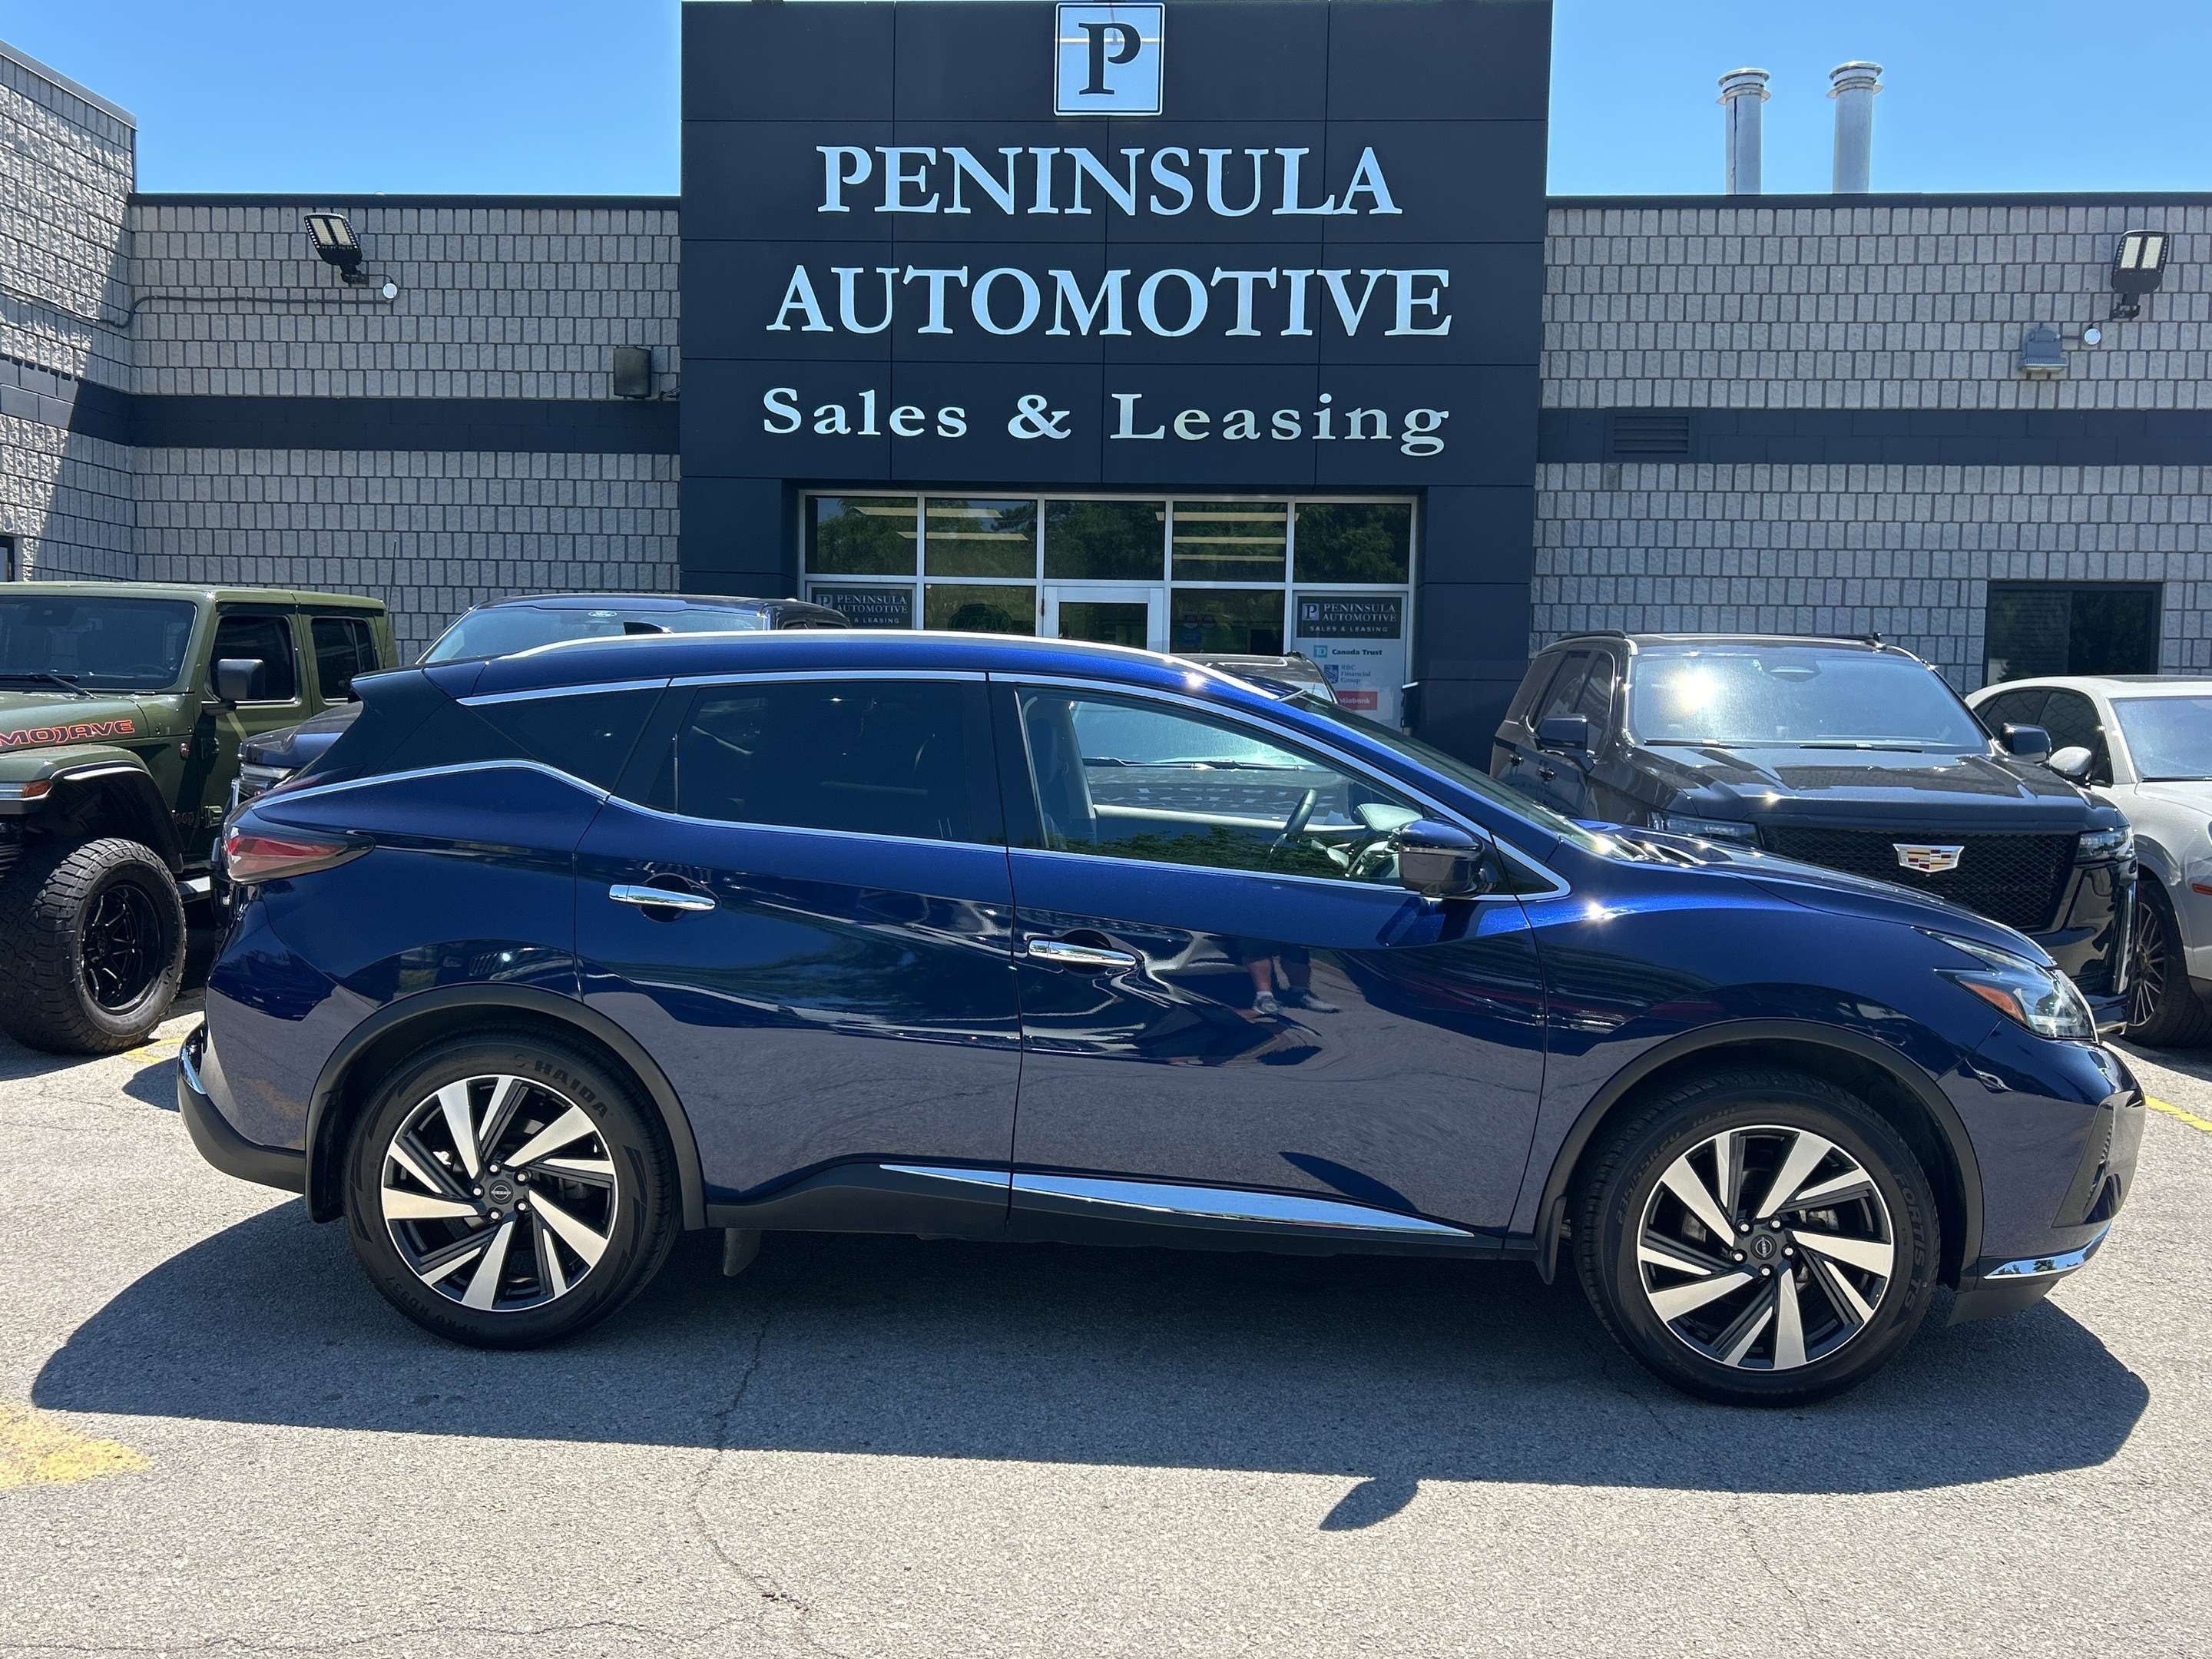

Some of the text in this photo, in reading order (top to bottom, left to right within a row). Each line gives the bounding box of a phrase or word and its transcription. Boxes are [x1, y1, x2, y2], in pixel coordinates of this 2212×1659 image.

[1078, 24, 1141, 95] P
[816, 145, 1403, 217] PENINSULA
[766, 264, 1452, 337] AUTOMOTIVE
[763, 387, 1449, 456] Sales & Leasing
[836, 594, 907, 604] PENINSULA
[836, 604, 909, 614] AUTOMOTIVE
[1323, 603, 1396, 613] PENINSULA
[1323, 613, 1397, 622] AUTOMOTIVE
[0, 719, 135, 747] MOJAVE
[534, 1059, 608, 1119] HAIDA
[1894, 1173, 1926, 1267] FORTIS
